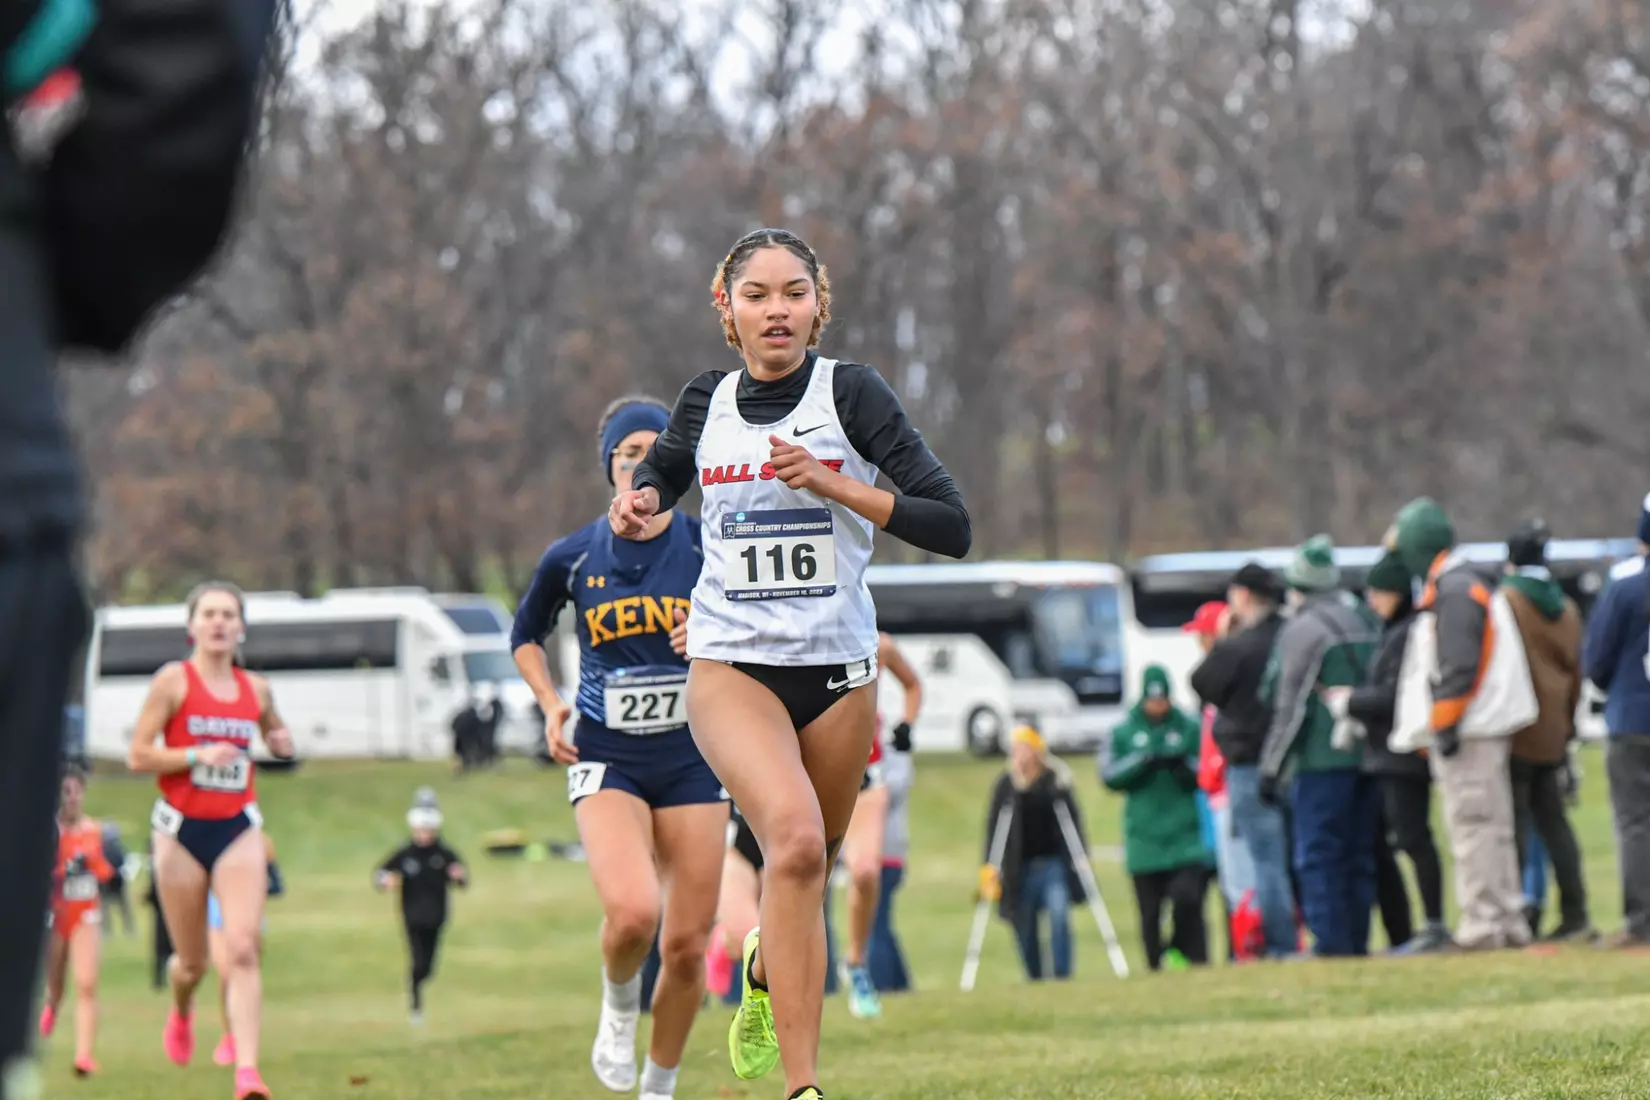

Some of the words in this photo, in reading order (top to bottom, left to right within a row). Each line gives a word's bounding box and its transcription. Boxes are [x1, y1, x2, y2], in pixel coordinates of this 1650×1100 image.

[702, 463, 755, 487] BALL
[735, 524, 754, 533] CROSS
[755, 523, 782, 532] COUNTRY
[782, 521, 832, 531] CHAMPIONSHIPS
[740, 543, 817, 582] 116
[620, 692, 679, 722] 227
